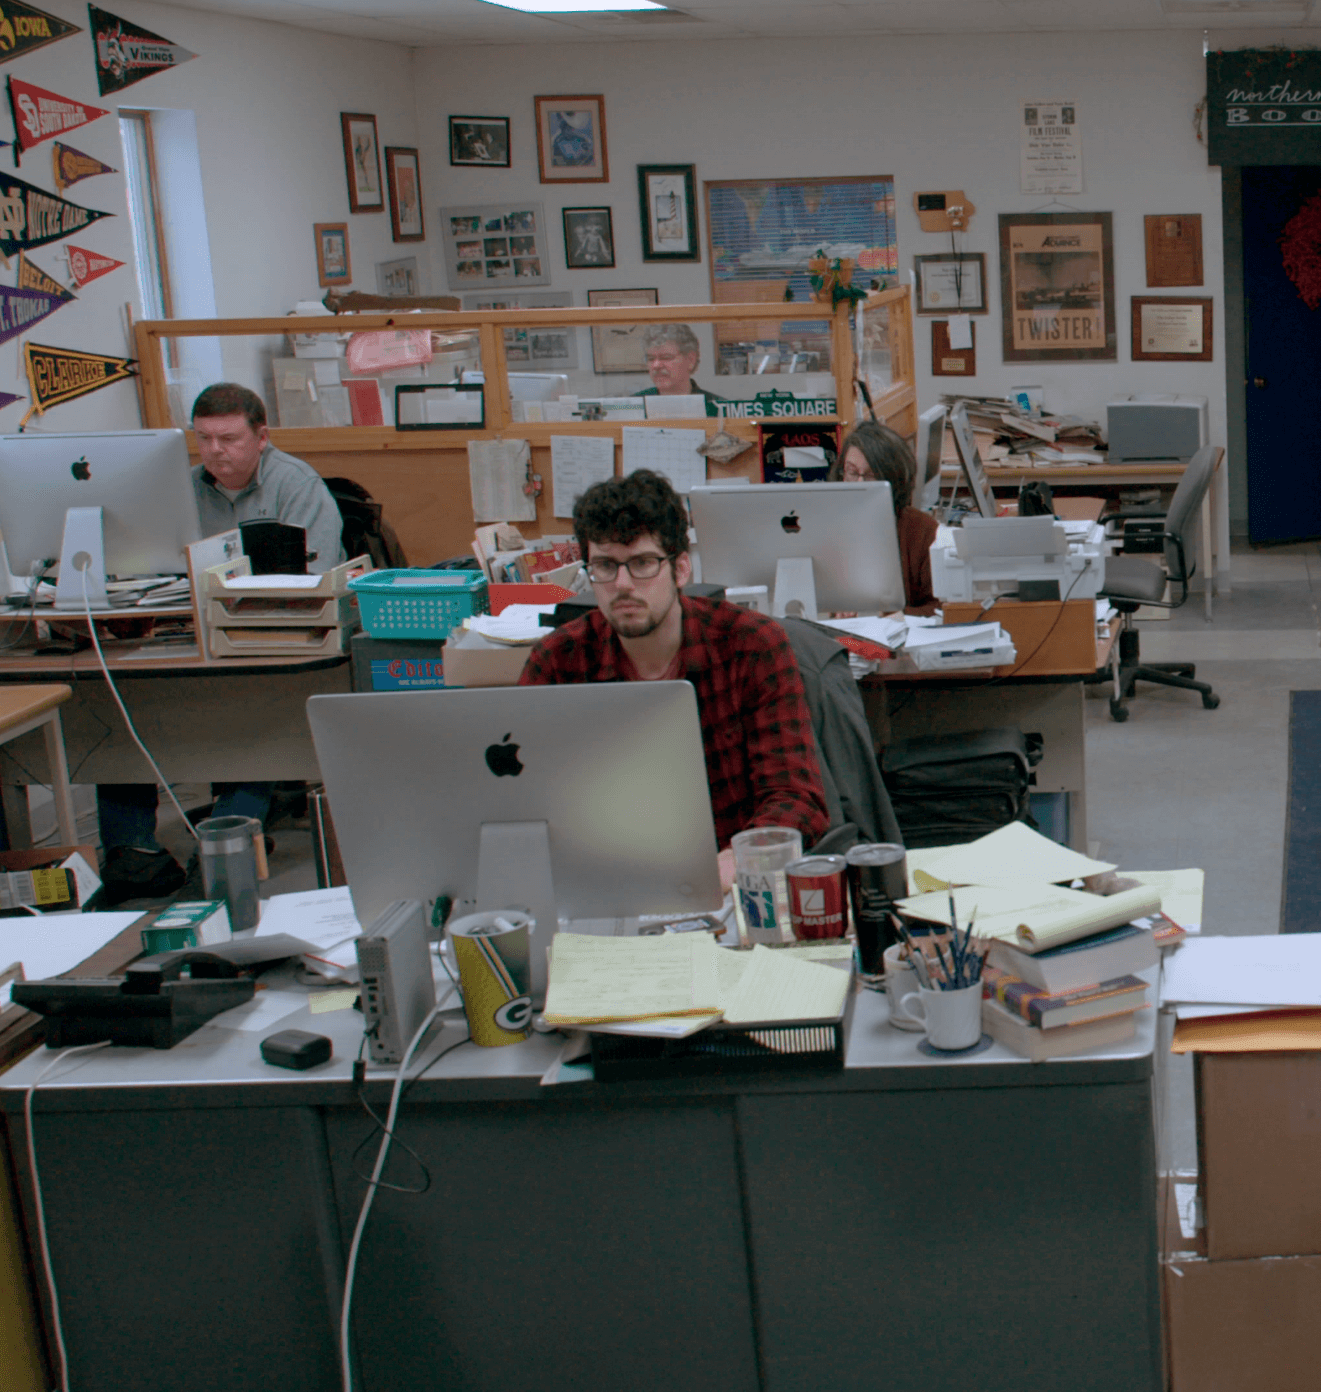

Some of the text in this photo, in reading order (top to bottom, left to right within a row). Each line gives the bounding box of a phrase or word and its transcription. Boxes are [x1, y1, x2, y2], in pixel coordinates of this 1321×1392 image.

[12, 16, 52, 37] IOWA
[40, 112, 89, 135] SOUTH DAKOTA
[1029, 126, 1072, 136] FILM FESTIVAL
[27, 189, 90, 241] NOTRE DAME
[23, 263, 65, 296] BELOIT
[34, 356, 107, 399] CLARKE
[715, 400, 836, 418] TIMES SQUARE
[782, 433, 821, 447] LAOS
[495, 996, 533, 1030] G
